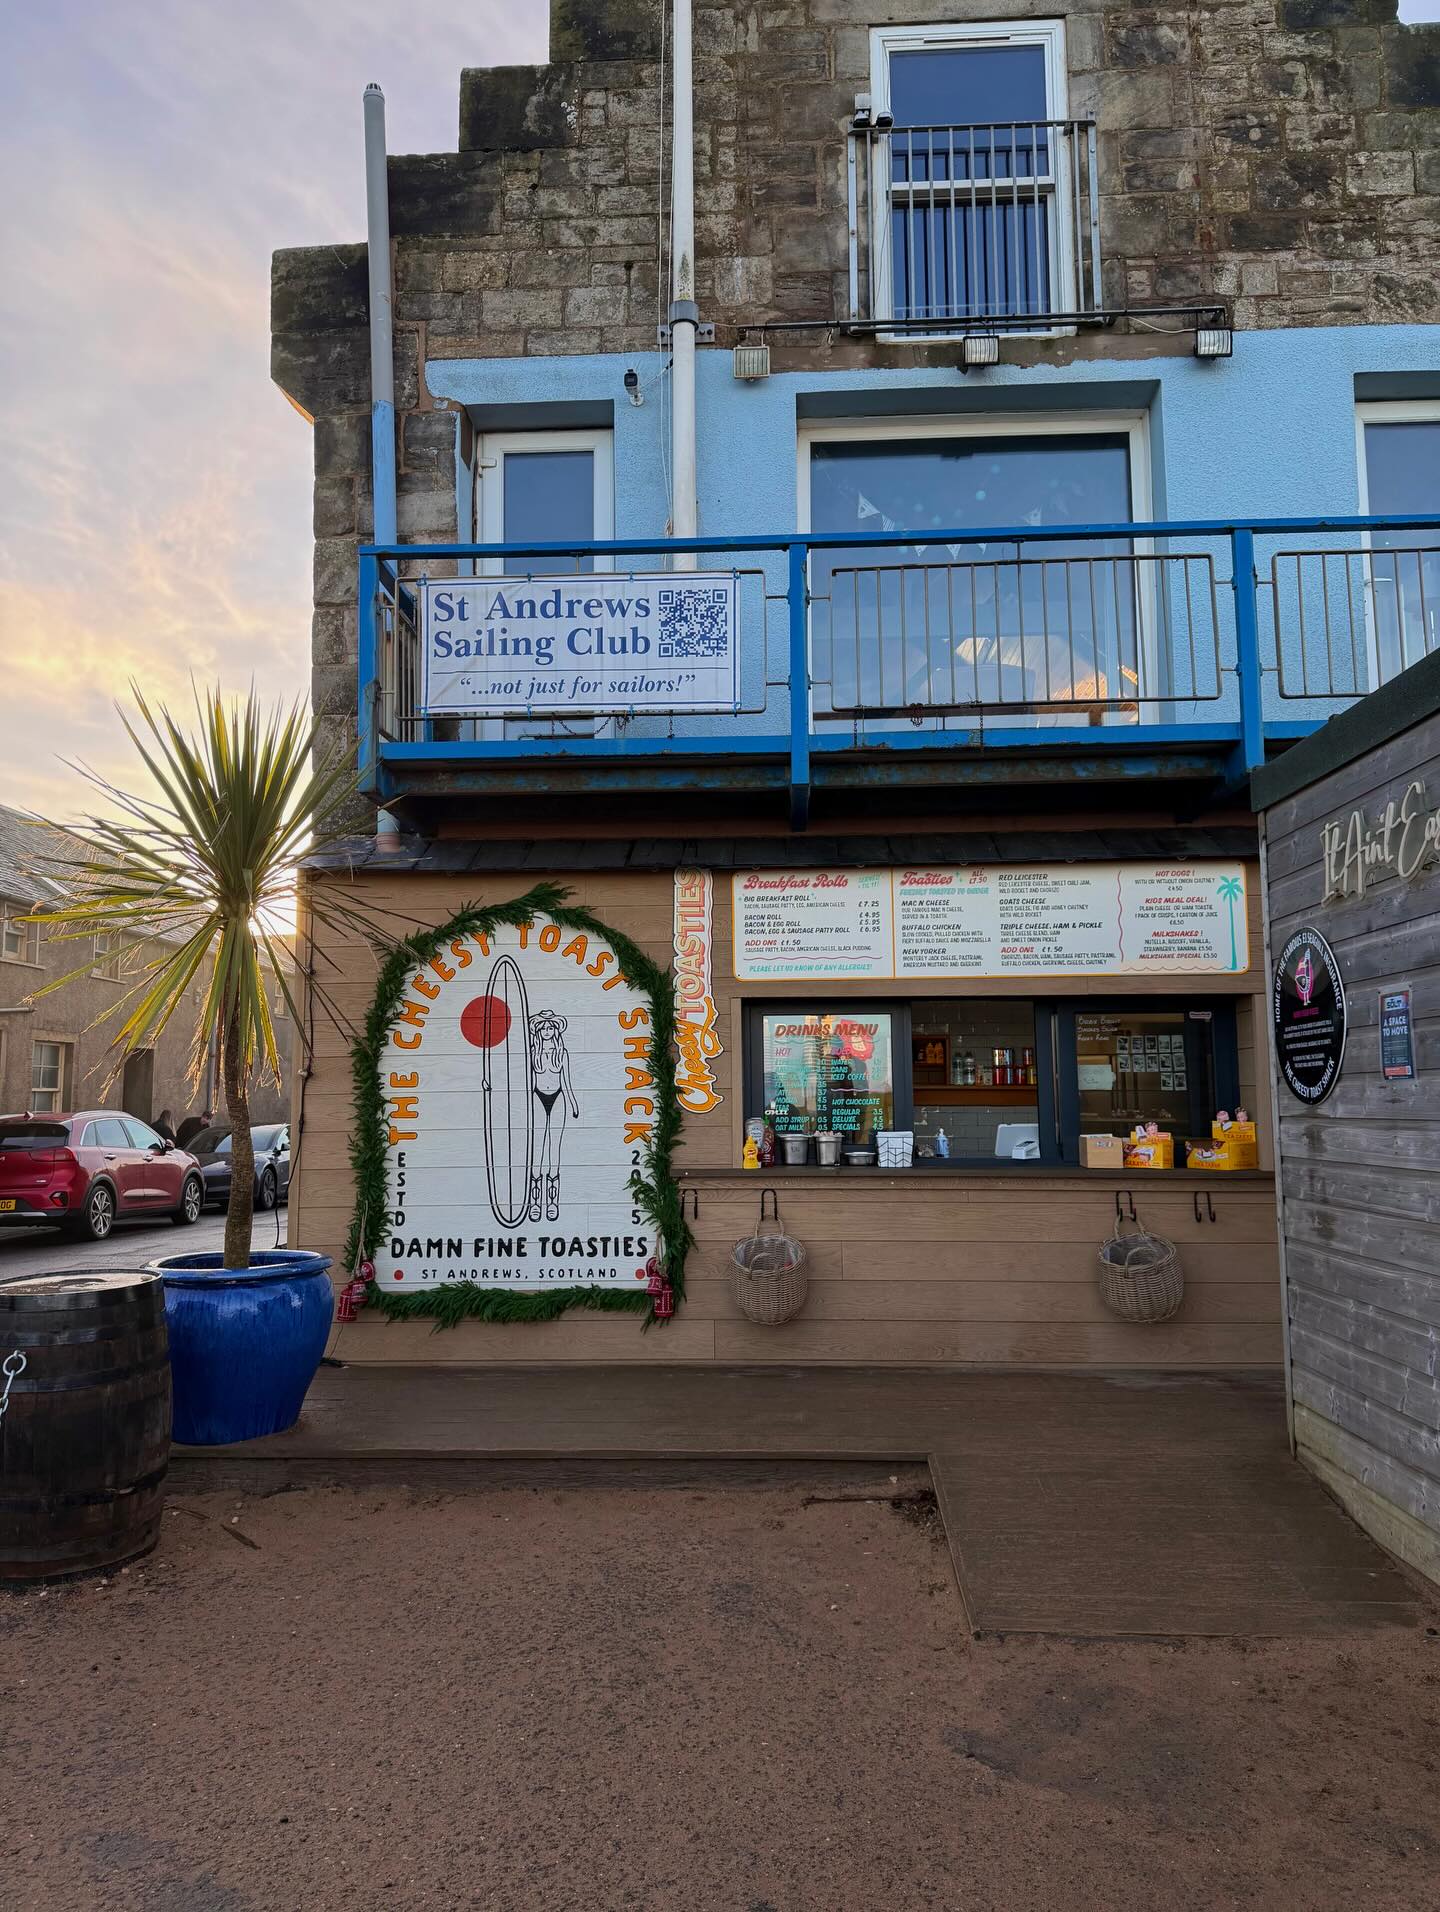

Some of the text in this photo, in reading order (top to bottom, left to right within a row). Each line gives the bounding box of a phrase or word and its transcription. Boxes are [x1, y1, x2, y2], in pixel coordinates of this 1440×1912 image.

[434, 589, 650, 621] St Andrews
[434, 627, 650, 666] Sailing Club
[526, 676, 564, 699] just
[569, 675, 602, 699] for
[744, 875, 809, 891] Breakfast
[812, 874, 848, 889] Rolls
[900, 871, 953, 886] Toasties
[1284, 934, 1302, 960] FAMOUS
[1307, 933, 1324, 957] SEAGULL
[1278, 958, 1287, 976] THE
[676, 868, 722, 1112] Cheesy TOASTIES
[1277, 979, 1281, 991] OF
[1323, 952, 1342, 1010] INSURANCE
[775, 1023, 878, 1038] DRINKS MENU
[1388, 1016, 1406, 1025] SPACE
[1391, 1026, 1408, 1035] MOVE
[389, 922, 654, 1145] THE CHEESY TOAST SHACK
[776, 1048, 792, 1056] HOT
[1285, 1062, 1294, 1081] THE
[1292, 1077, 1310, 1098] CHEESY
[1310, 1079, 1322, 1098] TOAST
[1321, 1058, 1335, 1086] SHACK
[394, 1152, 406, 1226] ESTD
[391, 1236, 648, 1258] DAMN FINE TOASTIES
[422, 1268, 618, 1280] ST ANDREWS, SCOTLAND
